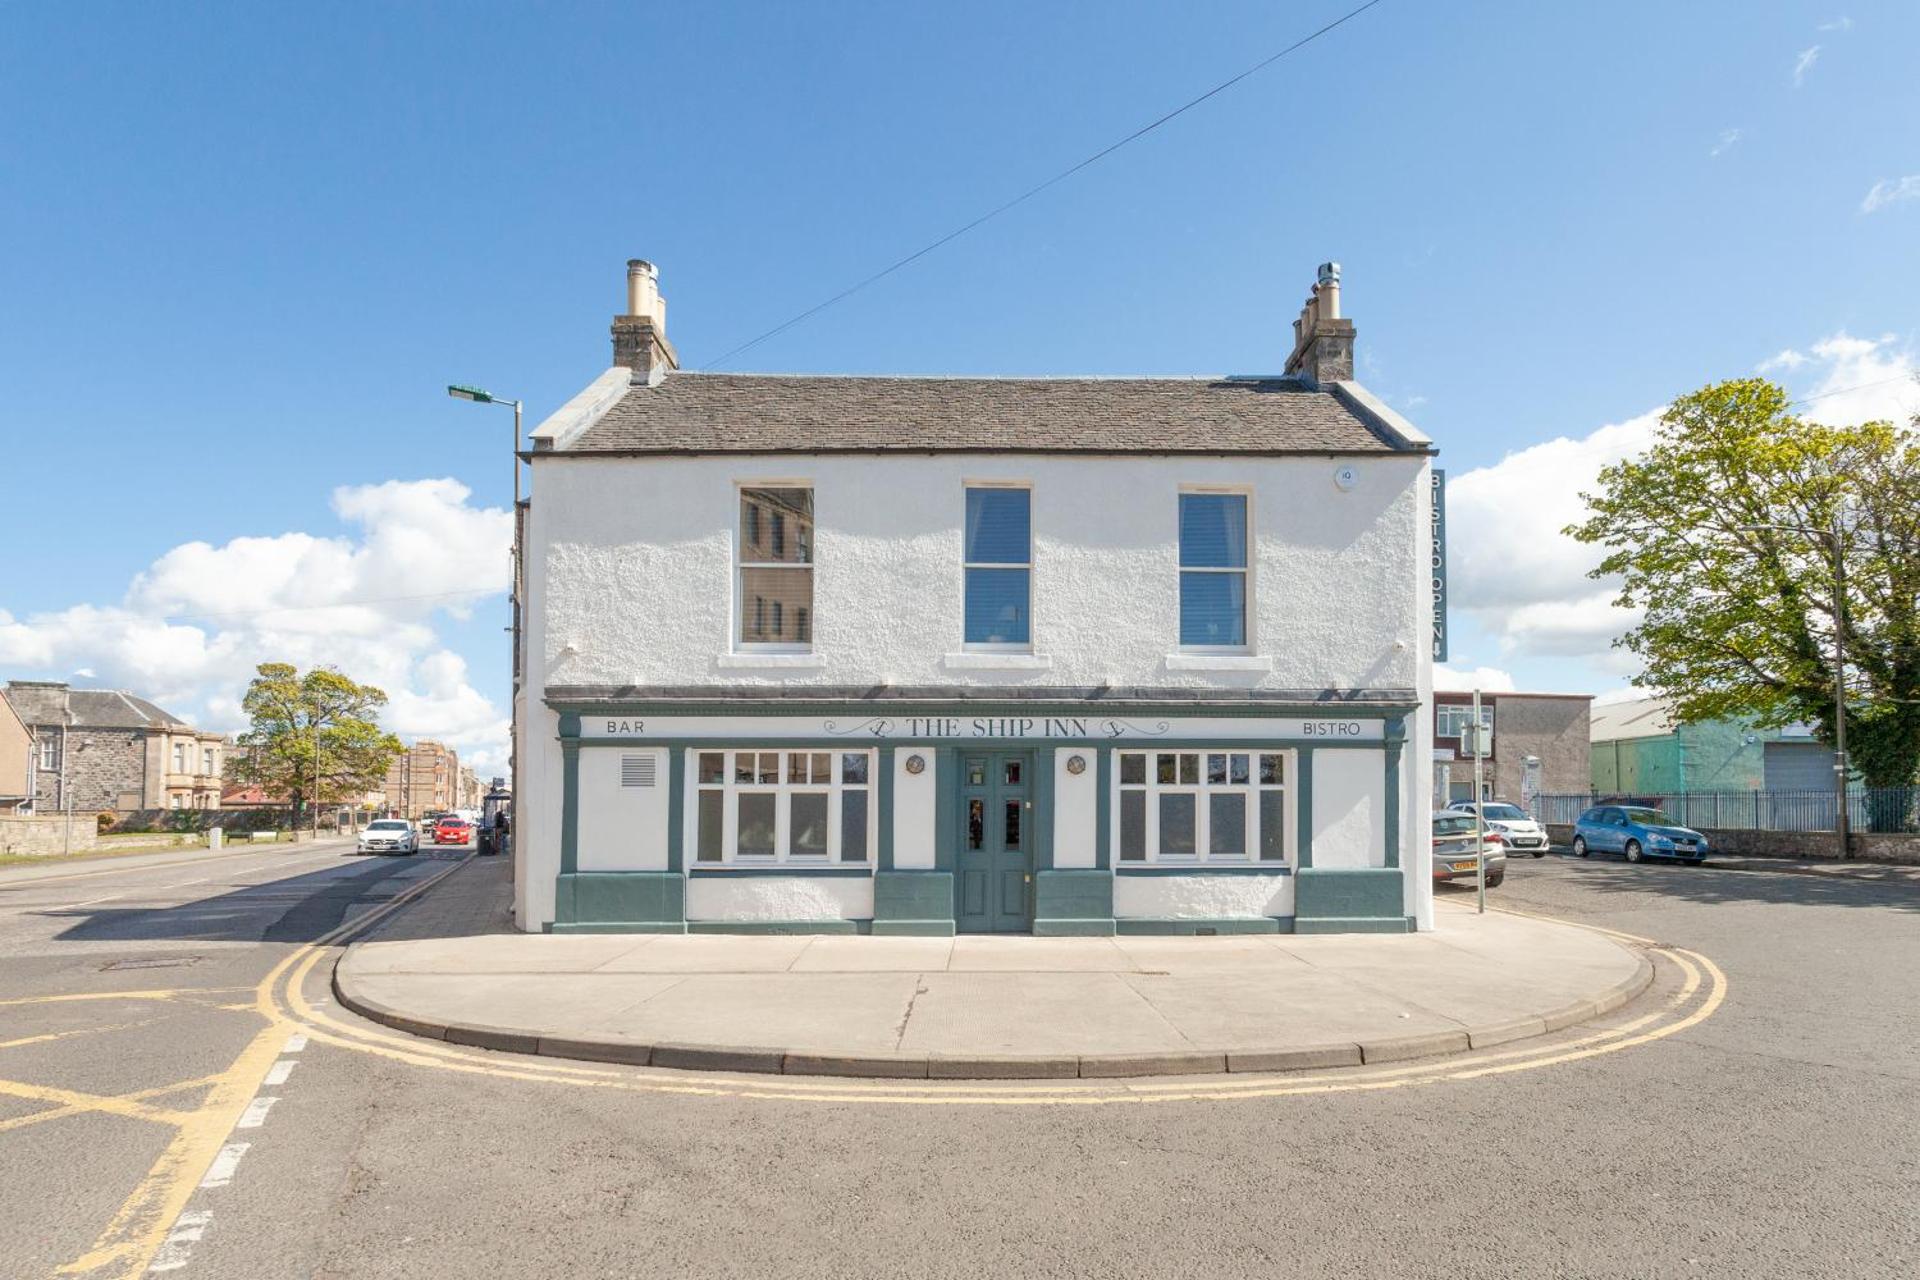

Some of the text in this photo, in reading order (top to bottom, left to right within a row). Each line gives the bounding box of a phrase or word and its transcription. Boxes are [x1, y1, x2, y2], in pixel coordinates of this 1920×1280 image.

[607, 721, 644, 733] BAR
[906, 718, 1087, 737] THE SHIP INN
[1303, 722, 1361, 736] BISTRO
